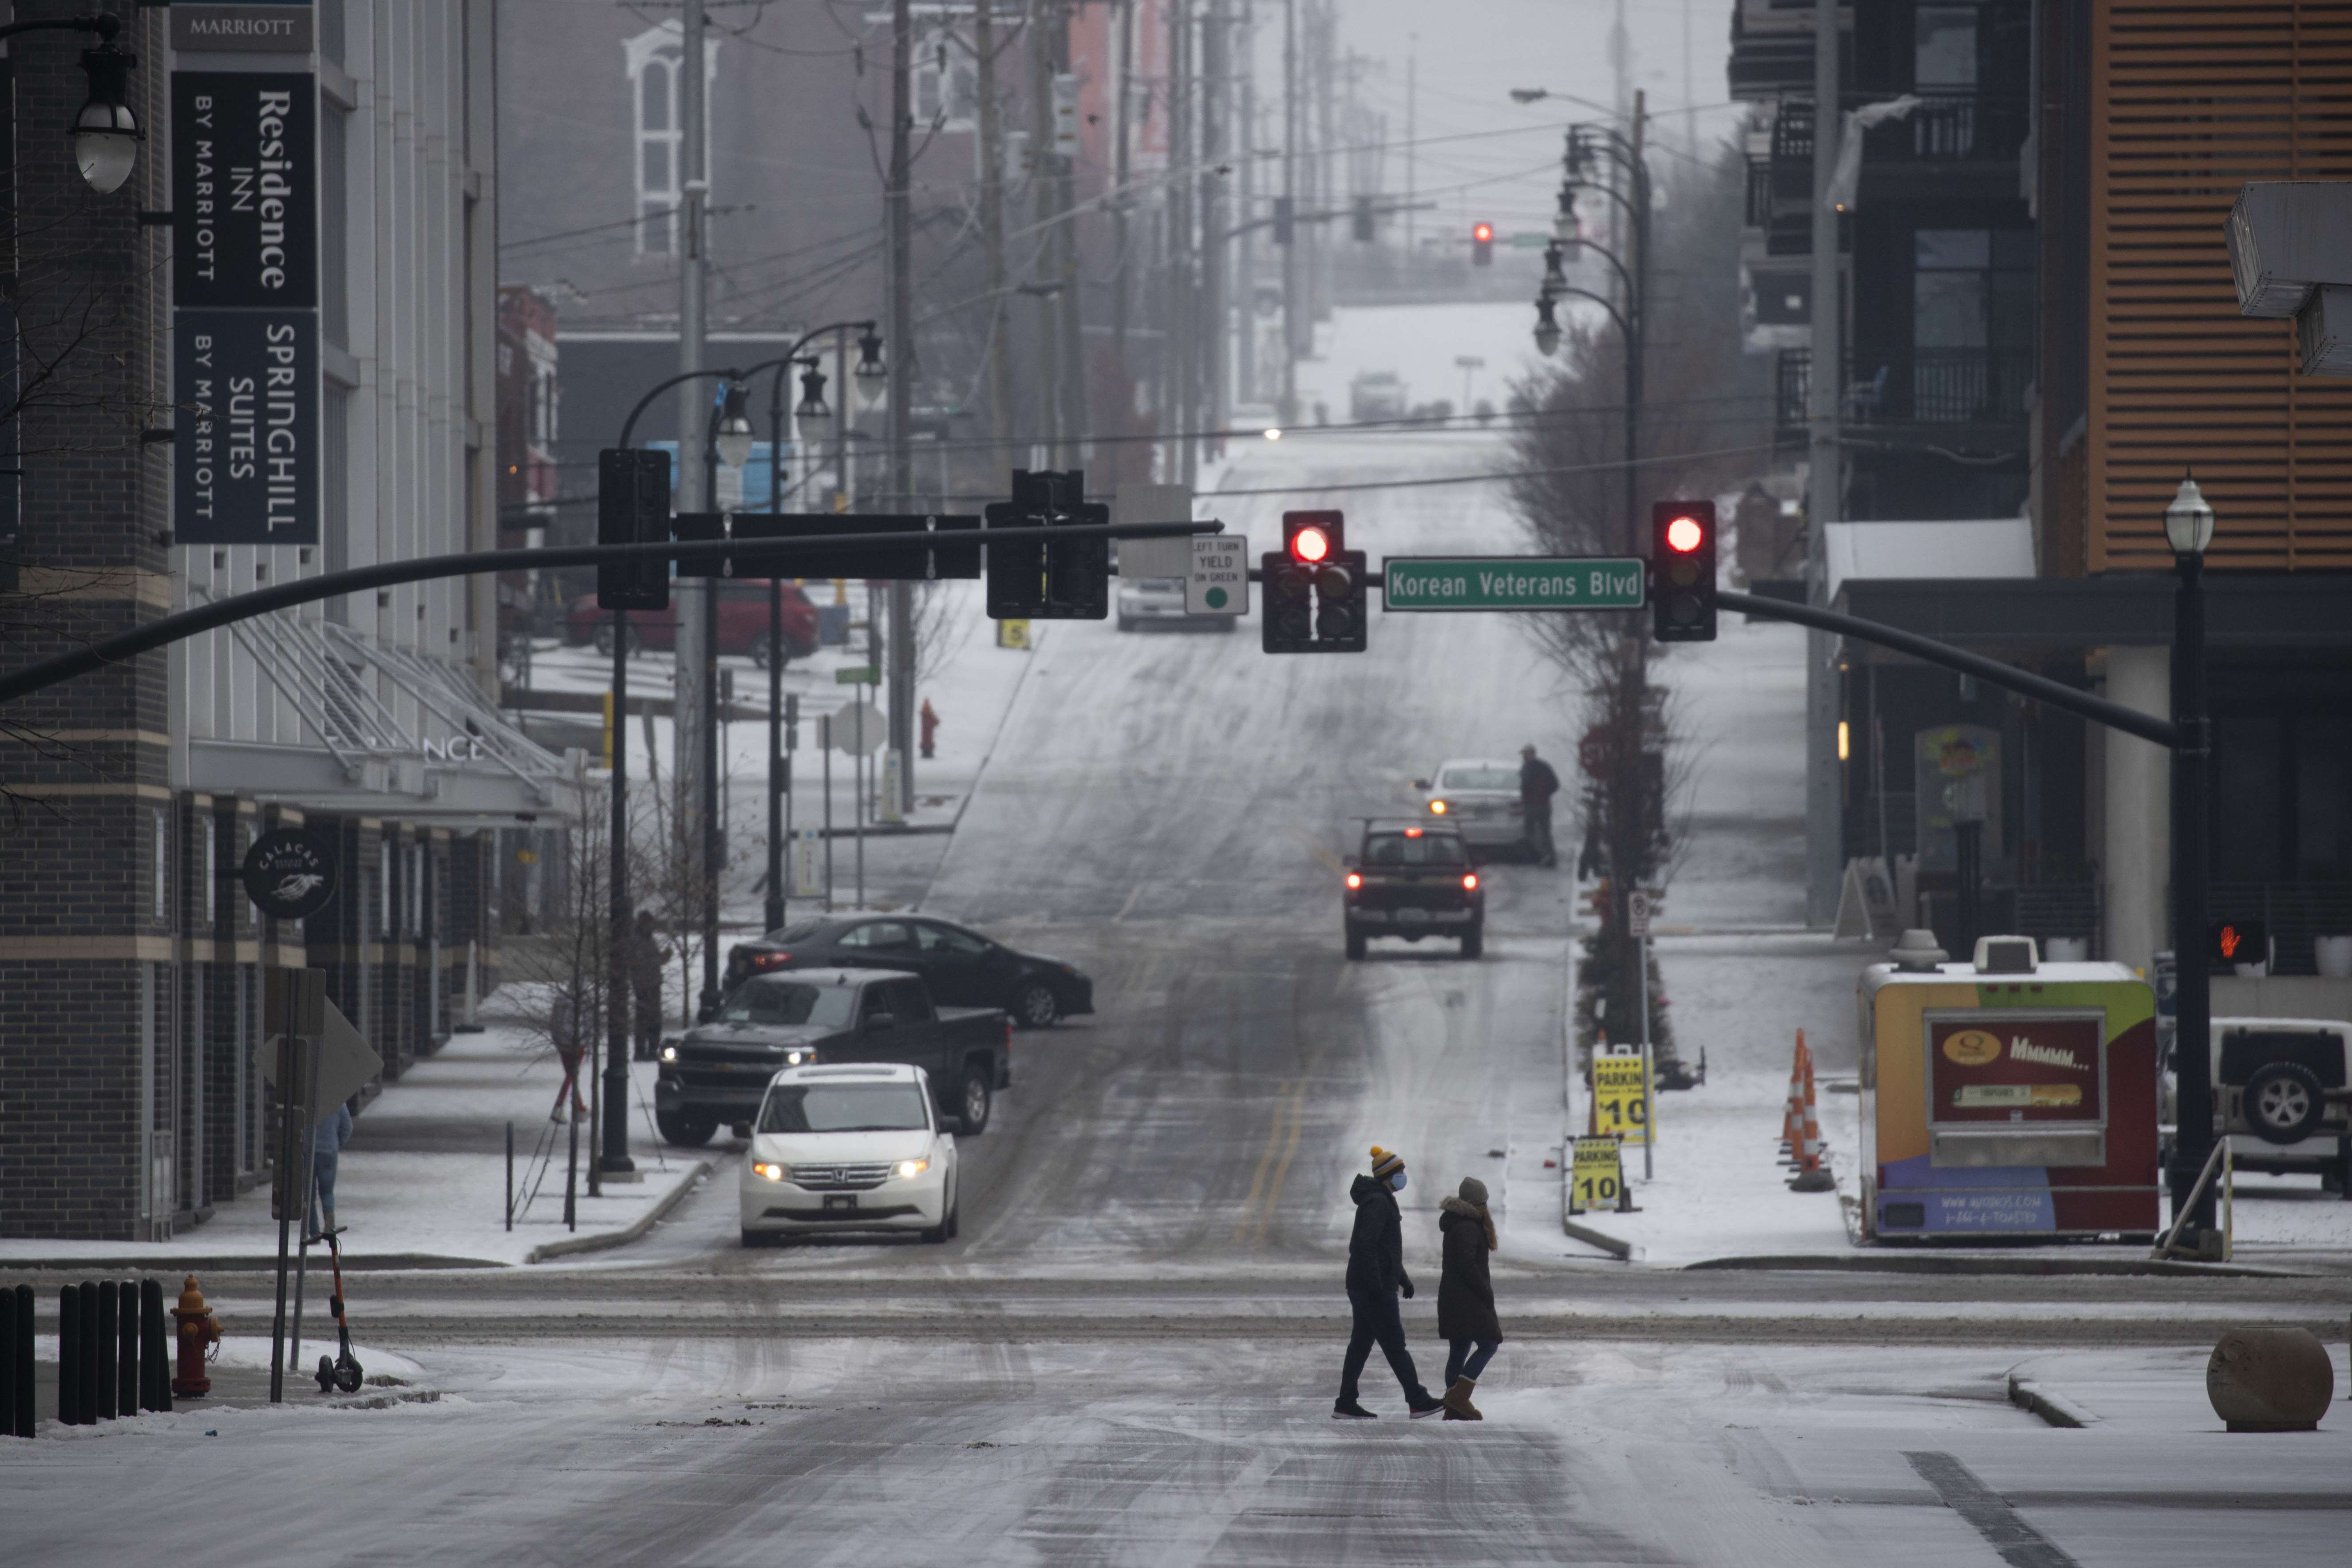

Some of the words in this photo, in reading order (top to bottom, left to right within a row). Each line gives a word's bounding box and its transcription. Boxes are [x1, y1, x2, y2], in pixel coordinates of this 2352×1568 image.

[190, 19, 295, 36] MARRIOTT
[195, 95, 213, 129] BY
[230, 167, 254, 211] INN
[259, 91, 293, 290] Residence
[196, 140, 214, 281] MARRIOTT
[195, 335, 212, 367] BY
[229, 377, 255, 479] SUITES
[266, 324, 296, 532] SPRINGHILL
[195, 379, 213, 520] MARRIOTT
[1193, 542, 1212, 552] LEFT
[1218, 542, 1239, 551] TURN
[1199, 556, 1233, 569] YIELD
[1194, 573, 1207, 582] ON
[1210, 573, 1238, 582] GREEN
[1392, 572, 1467, 596] Korean
[1479, 572, 1577, 596] Veterans
[1590, 571, 1637, 596] Blvd
[259, 841, 319, 871] CALACAS
[1597, 1072, 1644, 1086] PARKIN
[1574, 1150, 1617, 1162] PARKING
